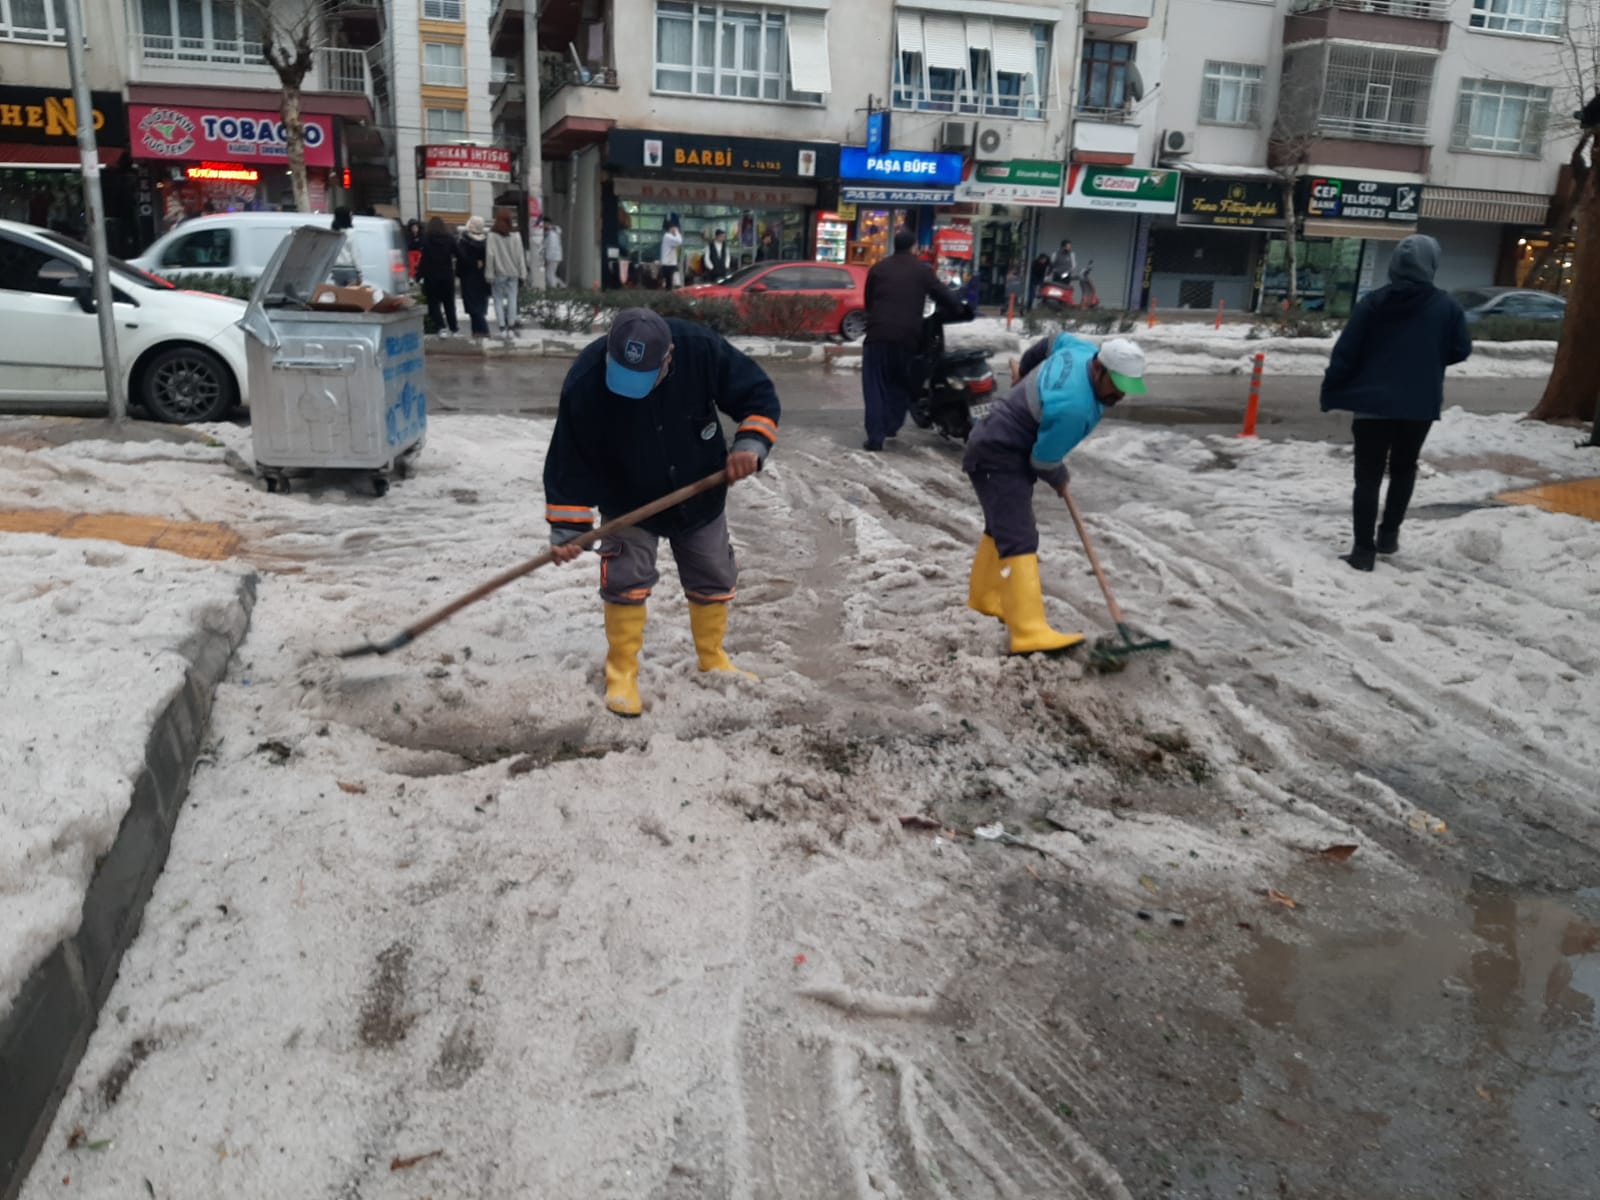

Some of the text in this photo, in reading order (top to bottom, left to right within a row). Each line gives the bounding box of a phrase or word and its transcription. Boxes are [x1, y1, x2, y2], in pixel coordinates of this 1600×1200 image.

[203, 117, 323, 147] TOBACO
[674, 147, 733, 167] BARBİ
[867, 157, 937, 174] PAŞA BÜFE
[1103, 177, 1137, 189] Castrol
[1358, 183, 1378, 193] CEP
[845, 190, 952, 202] PAŞA MARKET
[1313, 186, 1338, 198] CEP
[1342, 194, 1392, 206] TELEFONU
